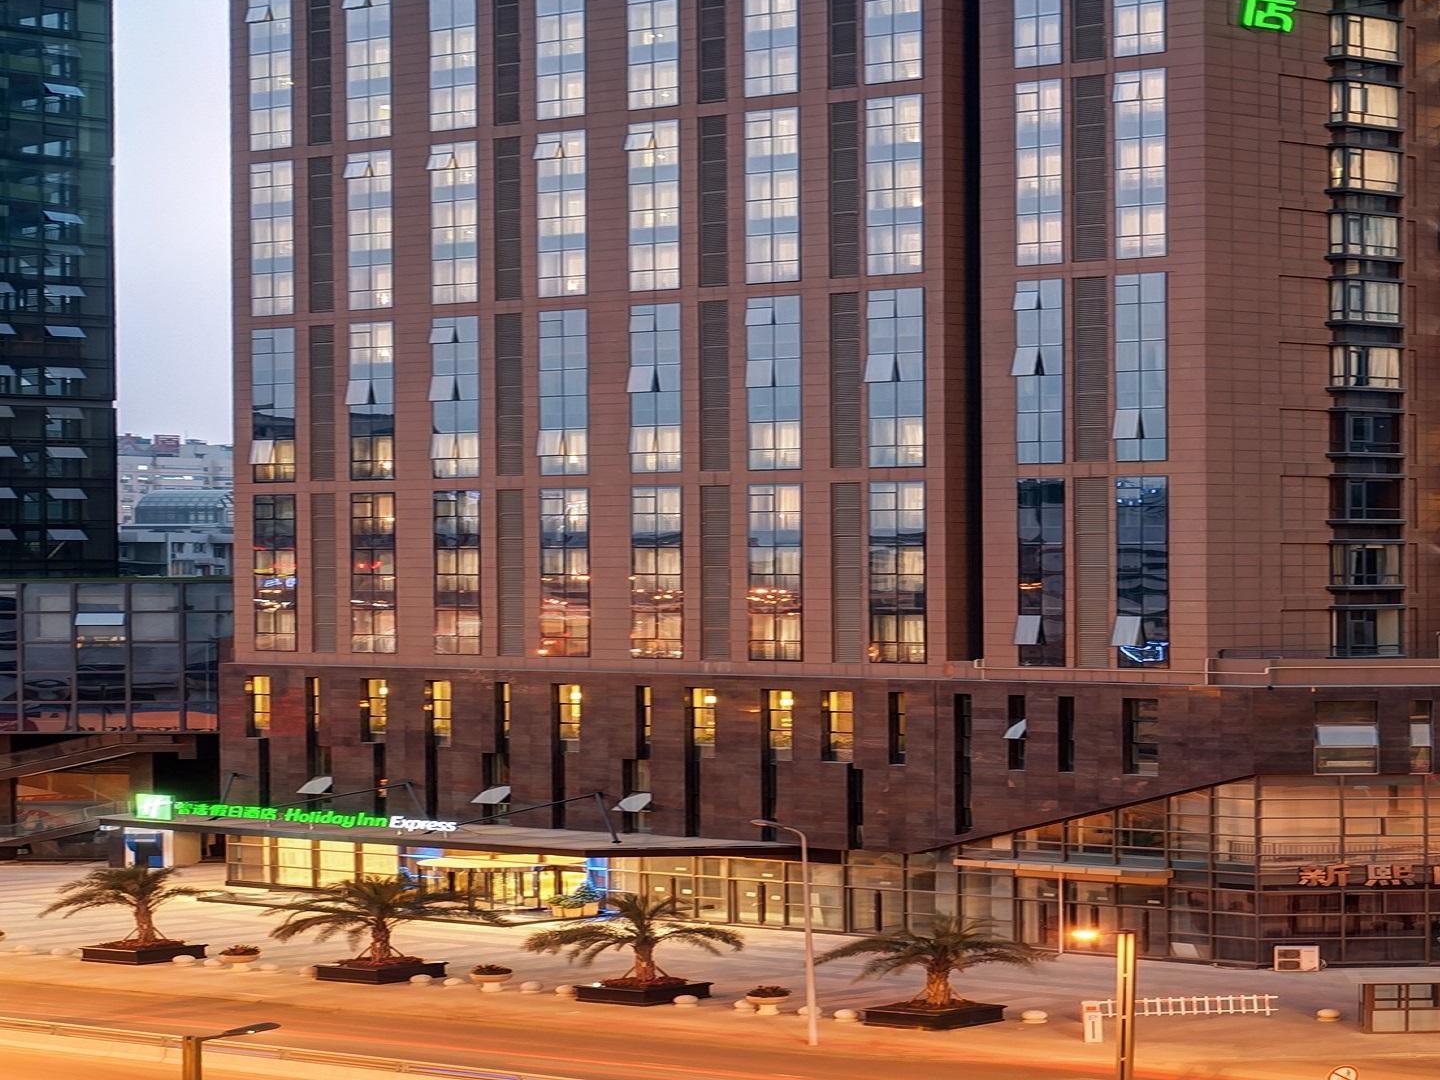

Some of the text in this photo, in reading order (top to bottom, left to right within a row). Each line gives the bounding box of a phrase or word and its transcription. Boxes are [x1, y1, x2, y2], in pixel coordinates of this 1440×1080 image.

[175, 801, 457, 833] 智选假日酒店 Holiday Inn Express
